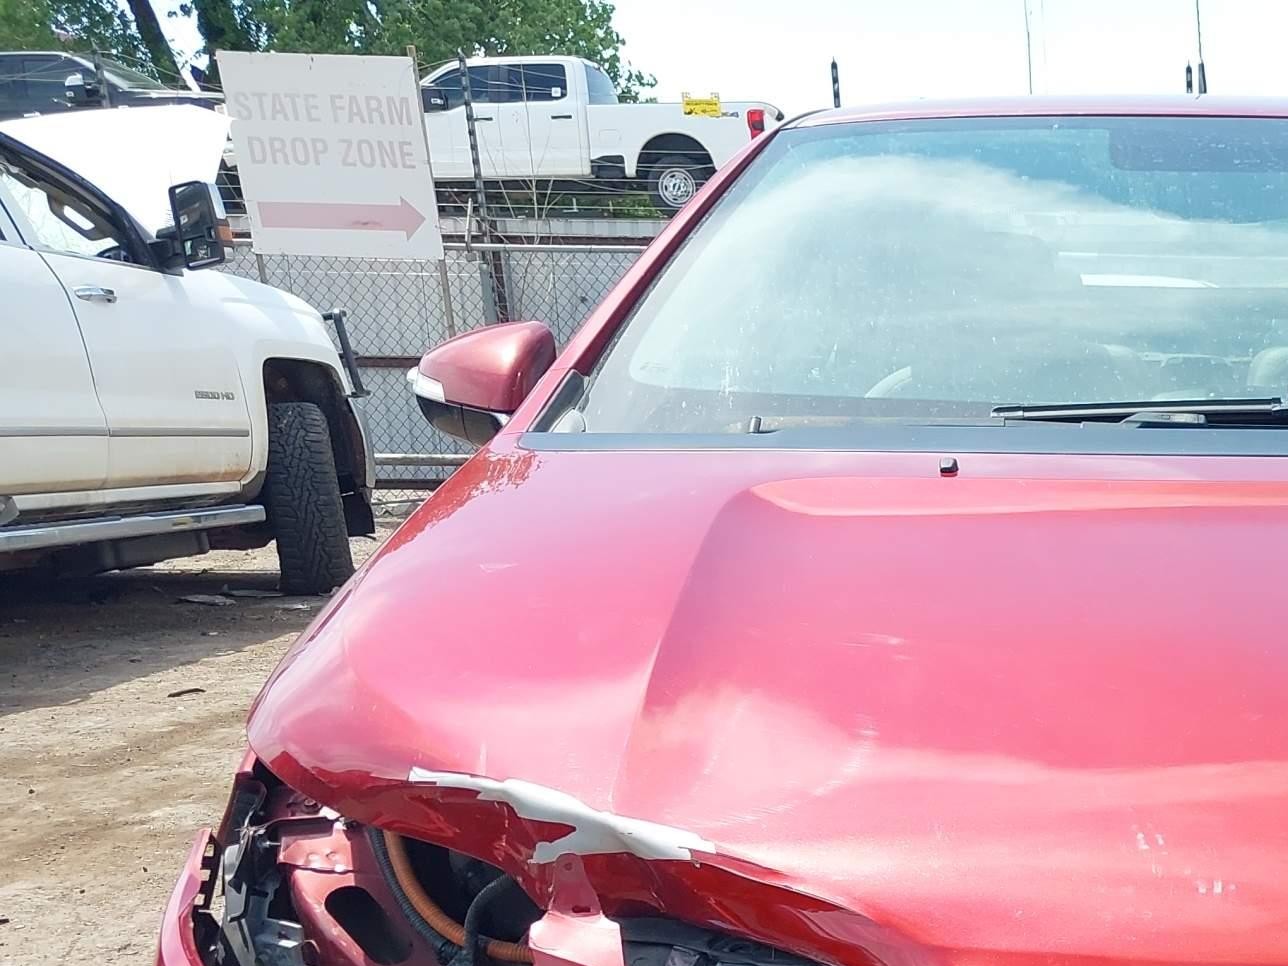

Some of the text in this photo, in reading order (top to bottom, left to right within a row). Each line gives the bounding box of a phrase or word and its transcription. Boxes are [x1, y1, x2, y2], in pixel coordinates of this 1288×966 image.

[232, 91, 413, 126] STATE FARM
[247, 135, 417, 169] DROP ZONE
